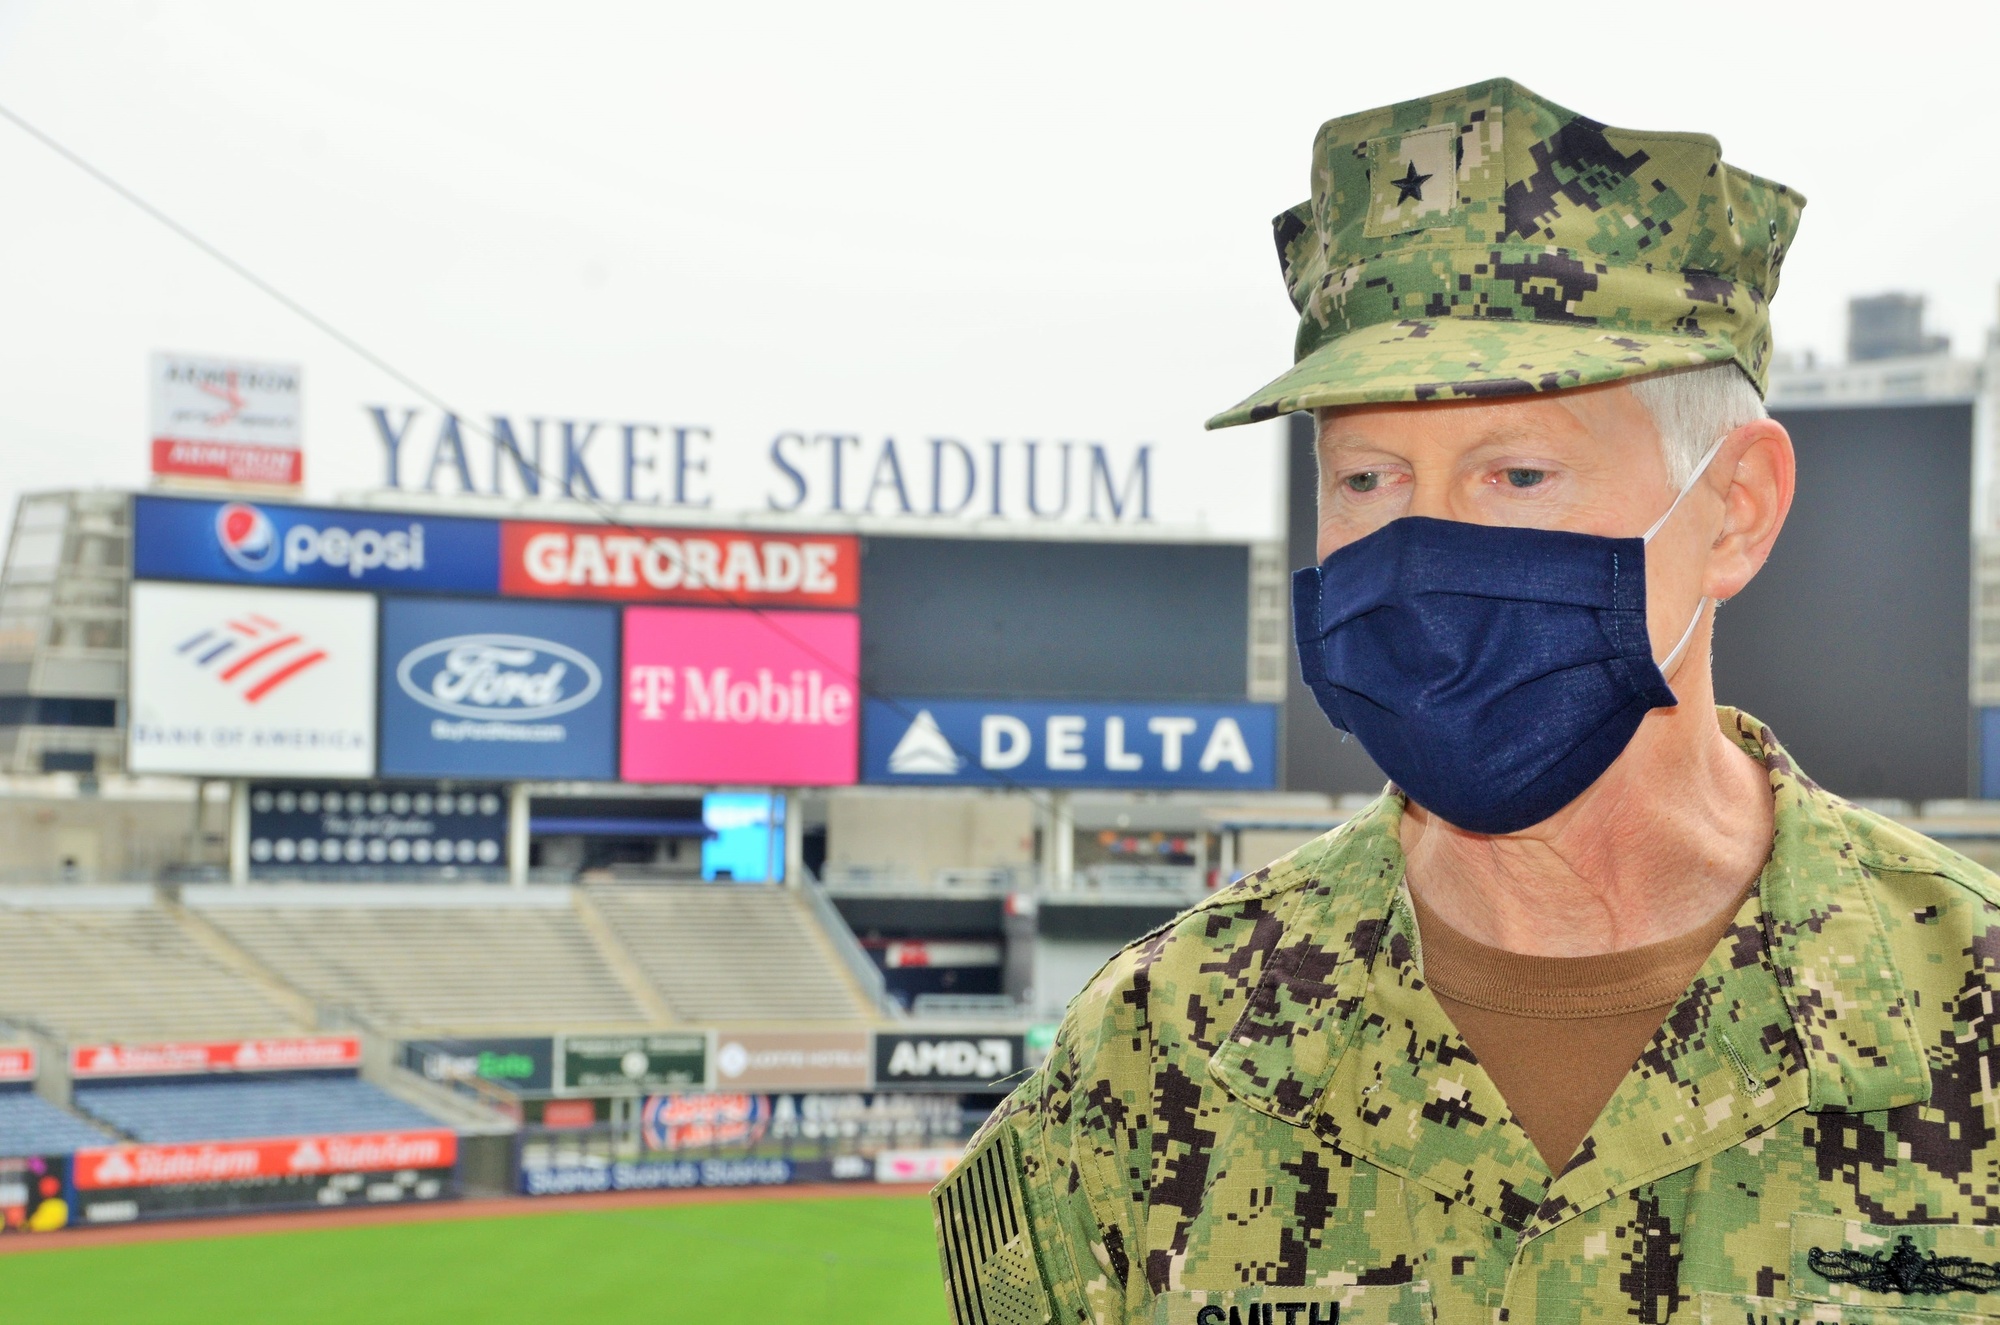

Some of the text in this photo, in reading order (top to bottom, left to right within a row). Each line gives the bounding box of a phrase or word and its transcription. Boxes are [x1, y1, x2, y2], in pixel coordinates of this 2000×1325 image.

[365, 404, 1158, 523] YANKEE STADIUM
[283, 522, 425, 577] pepsi
[523, 532, 837, 594] GATORADE
[432, 644, 569, 708] Ford
[682, 666, 853, 727] Mobile
[980, 714, 1253, 773] DELTA
[888, 1041, 975, 1076] AMD
